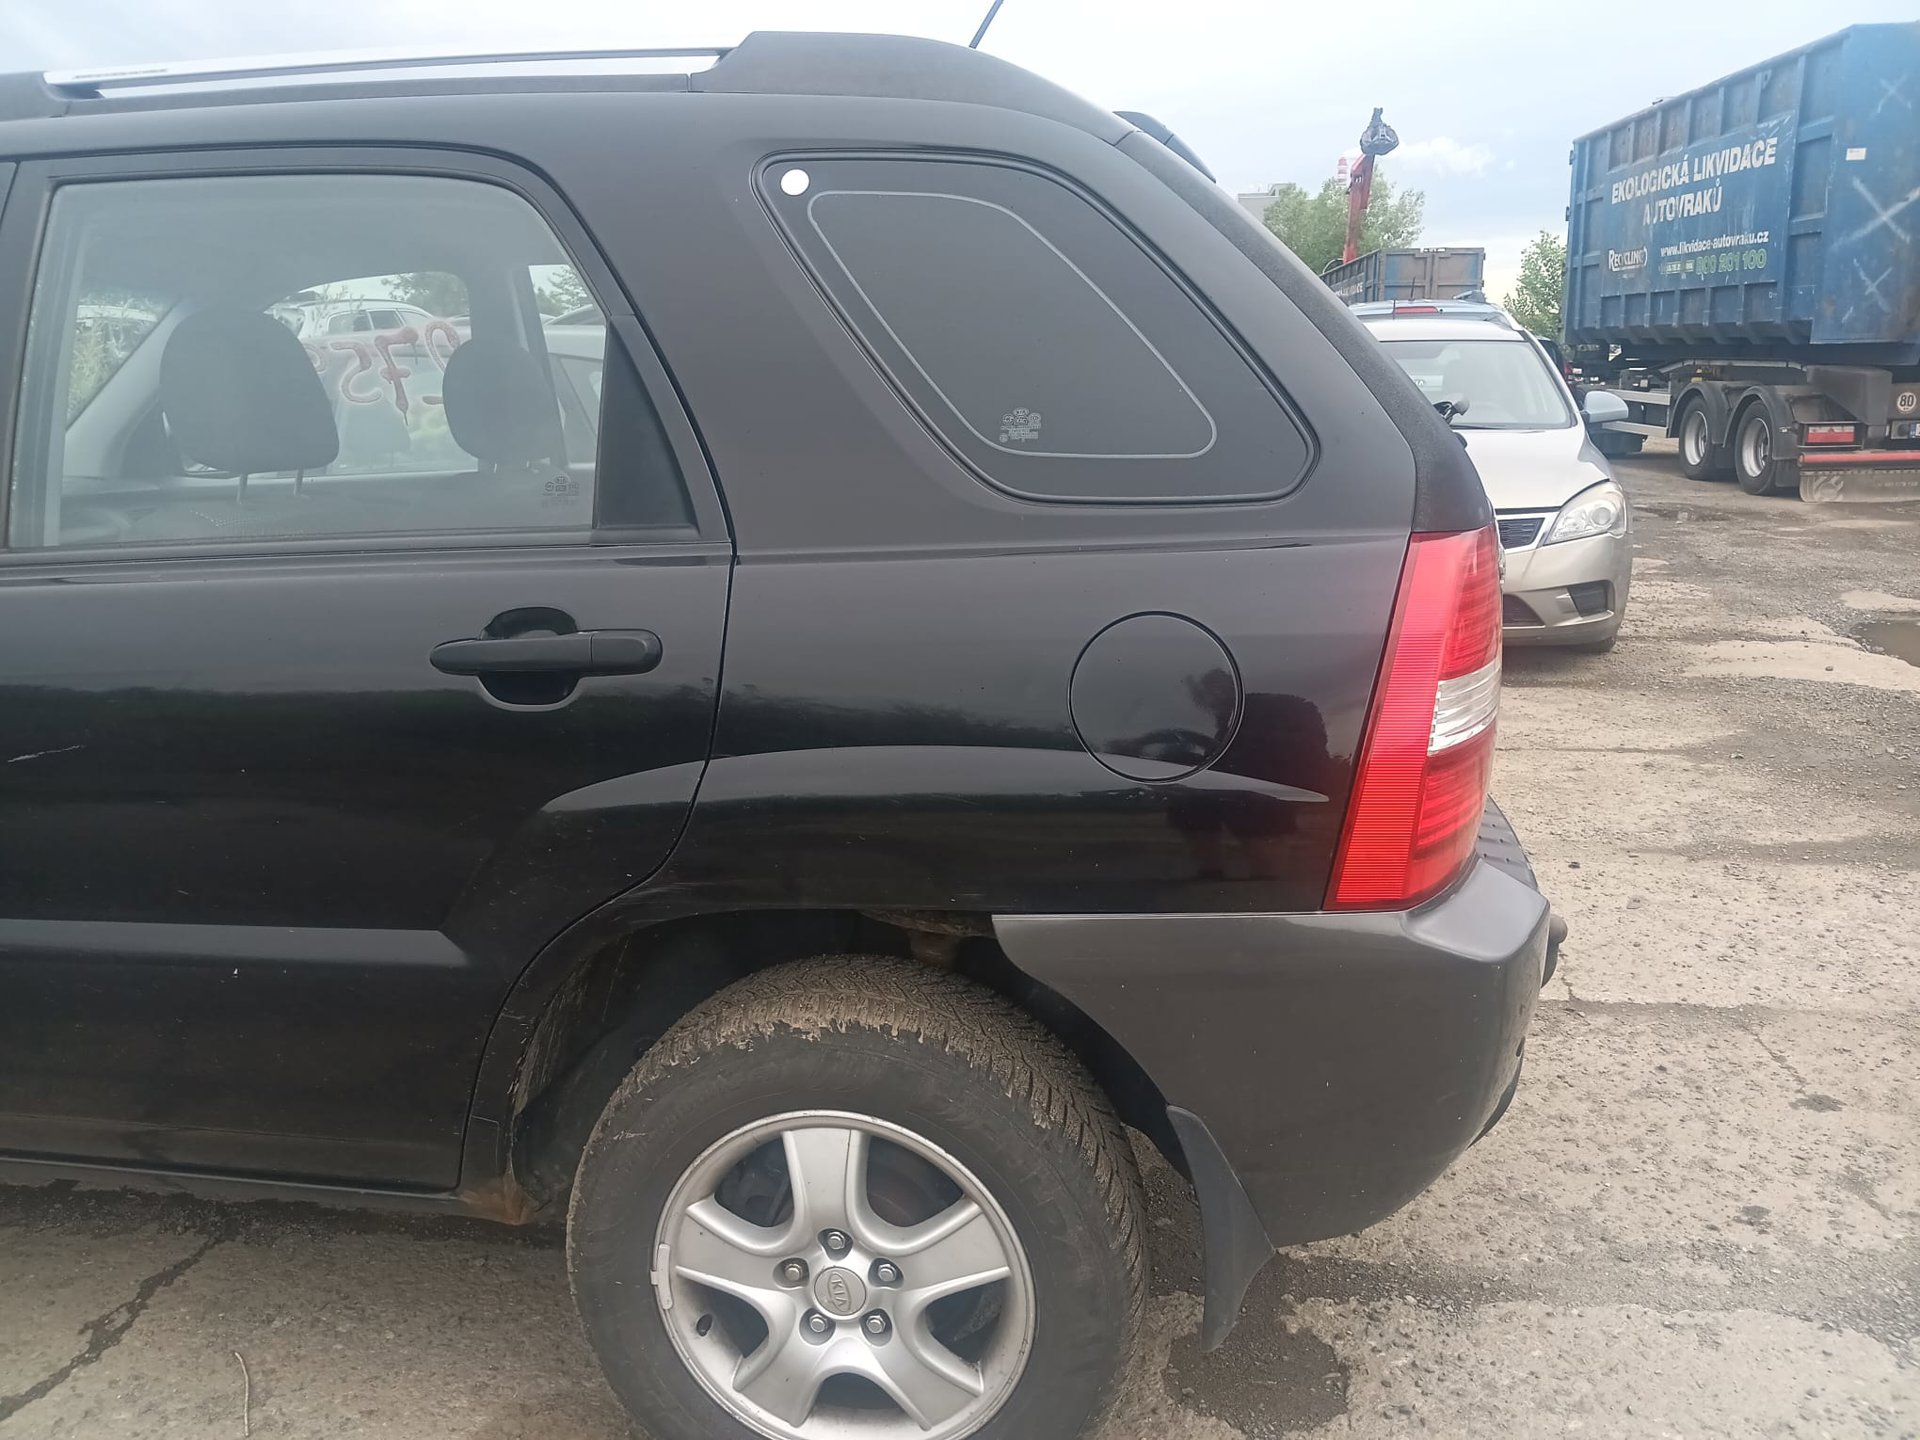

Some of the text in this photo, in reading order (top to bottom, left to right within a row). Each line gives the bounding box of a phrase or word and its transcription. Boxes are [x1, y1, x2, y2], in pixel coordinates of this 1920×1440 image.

[1611, 137, 1778, 205] EKOLOGICKÁ LIKVIDACE
[1660, 231, 1769, 257] www.likvidace-autovraku.cz
[1900, 395, 1914, 407] 80
